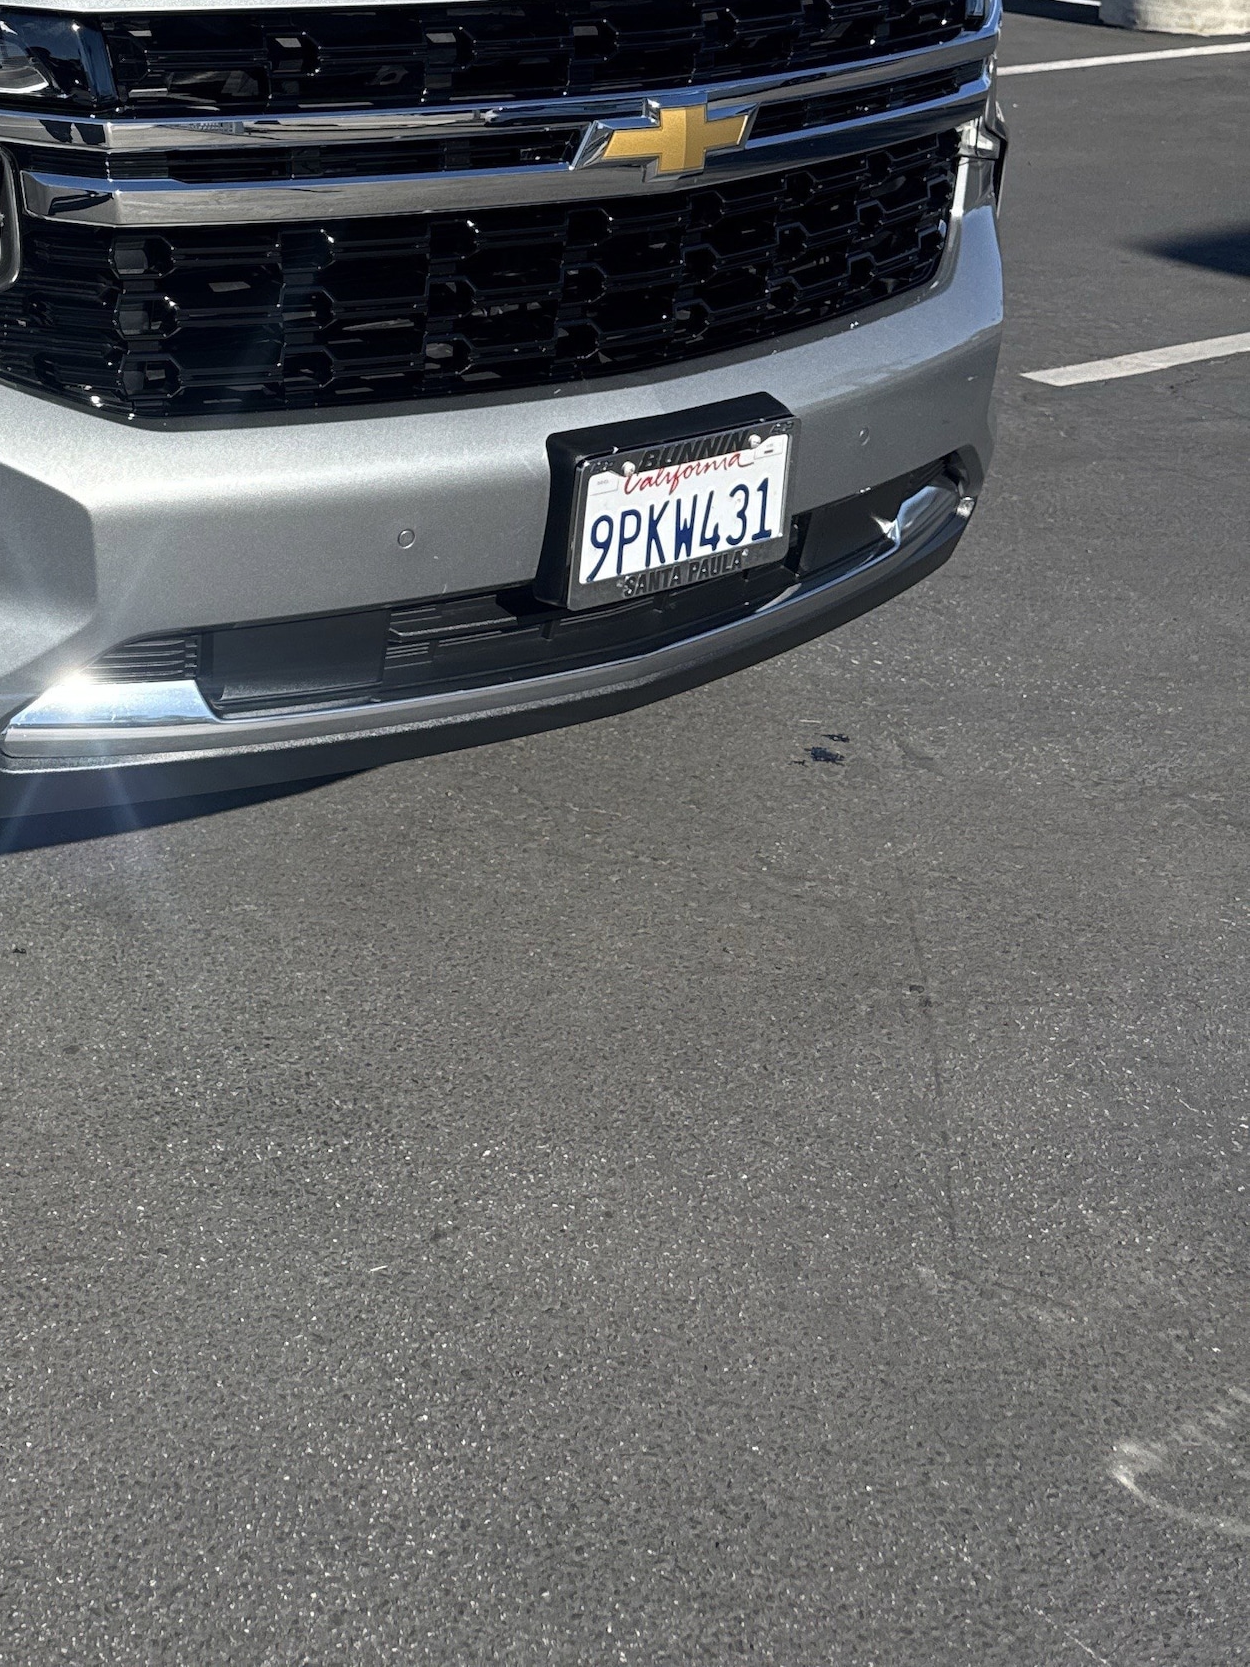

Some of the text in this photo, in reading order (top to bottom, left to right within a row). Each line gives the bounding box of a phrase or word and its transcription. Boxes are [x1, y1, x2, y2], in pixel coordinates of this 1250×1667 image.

[623, 451, 755, 495] California
[636, 428, 750, 474] BUNNIN
[588, 476, 772, 582] 9PKW431
[622, 548, 744, 598] SANTA PAULA
